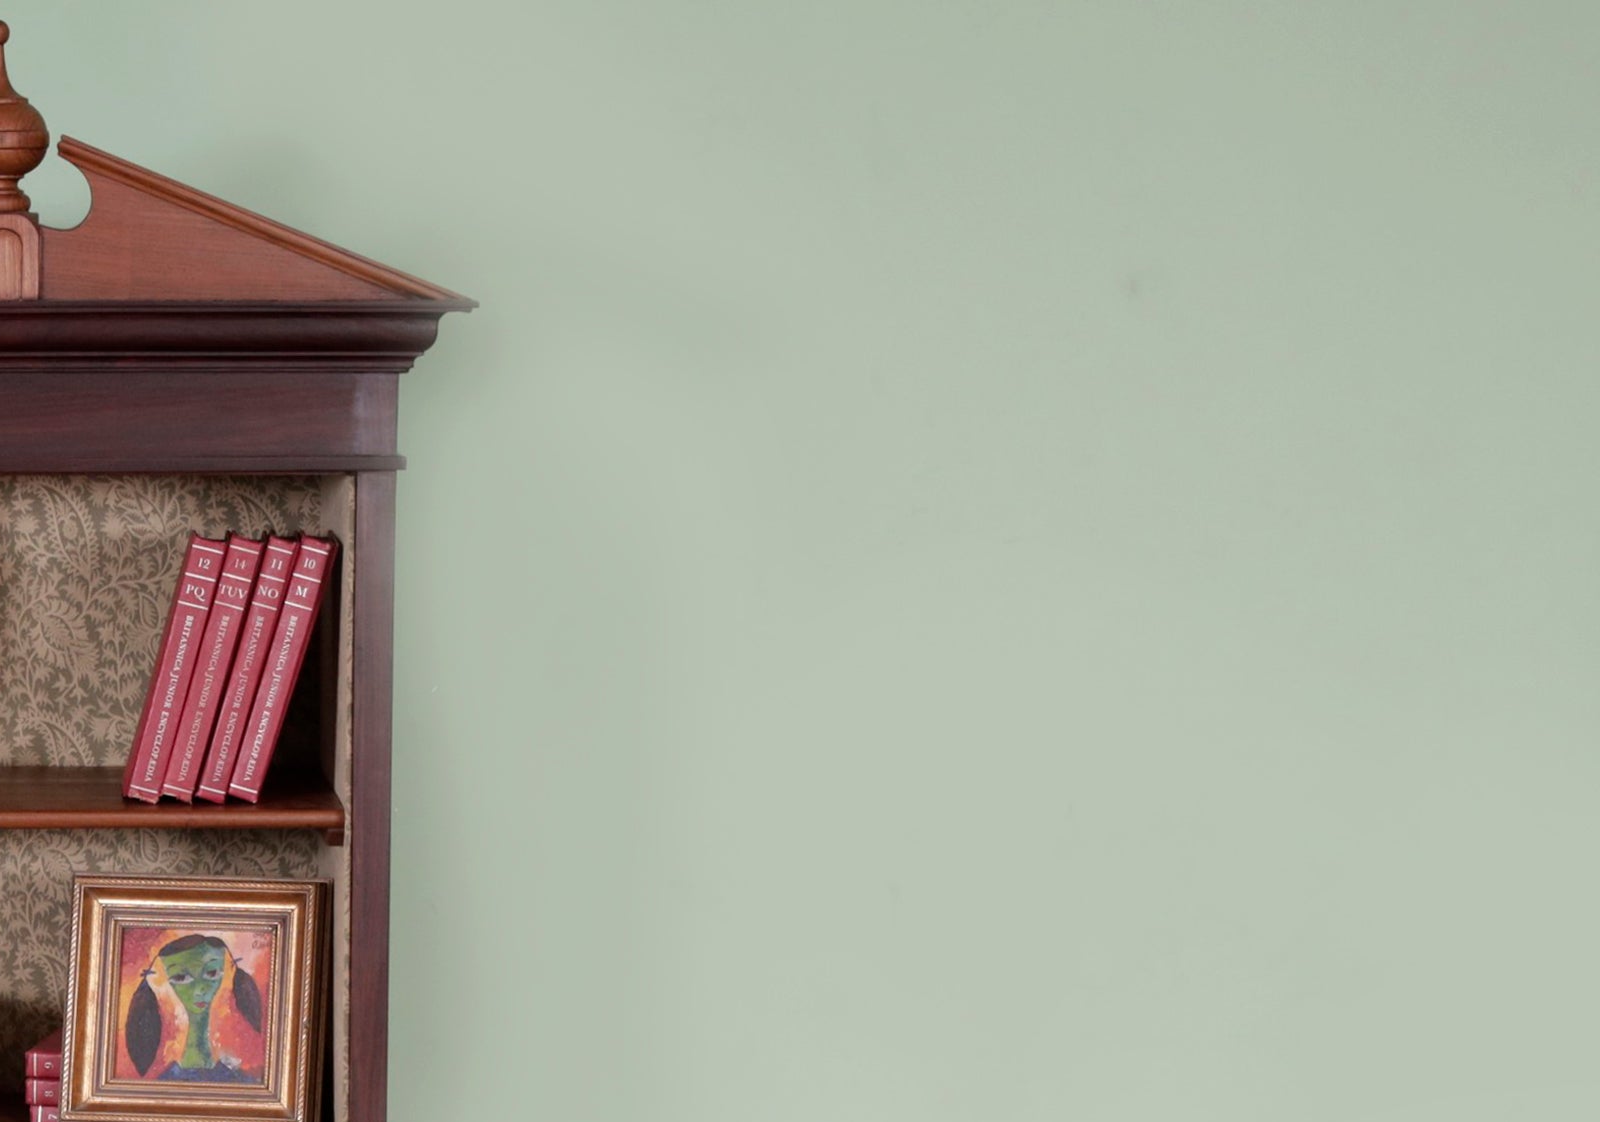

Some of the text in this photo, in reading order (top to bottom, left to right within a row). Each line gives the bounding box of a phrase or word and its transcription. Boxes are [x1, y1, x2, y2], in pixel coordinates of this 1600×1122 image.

[198, 557, 211, 570] 12
[234, 558, 247, 570] 14
[271, 558, 284, 570] 11
[303, 557, 316, 570] 10
[185, 584, 206, 602] PQ
[219, 583, 248, 600] TUV
[257, 585, 279, 599] NO
[295, 585, 308, 598] M
[173, 615, 194, 671] BRITANNICA
[208, 615, 230, 671] BRITANNICA
[243, 615, 265, 671] BRITANNICA
[275, 615, 298, 671] BRITANNICA
[163, 671, 179, 708] JUNIOR
[198, 671, 214, 708] JUNIOR
[232, 672, 248, 709] JUNIOR
[265, 671, 282, 708] JUNIOR
